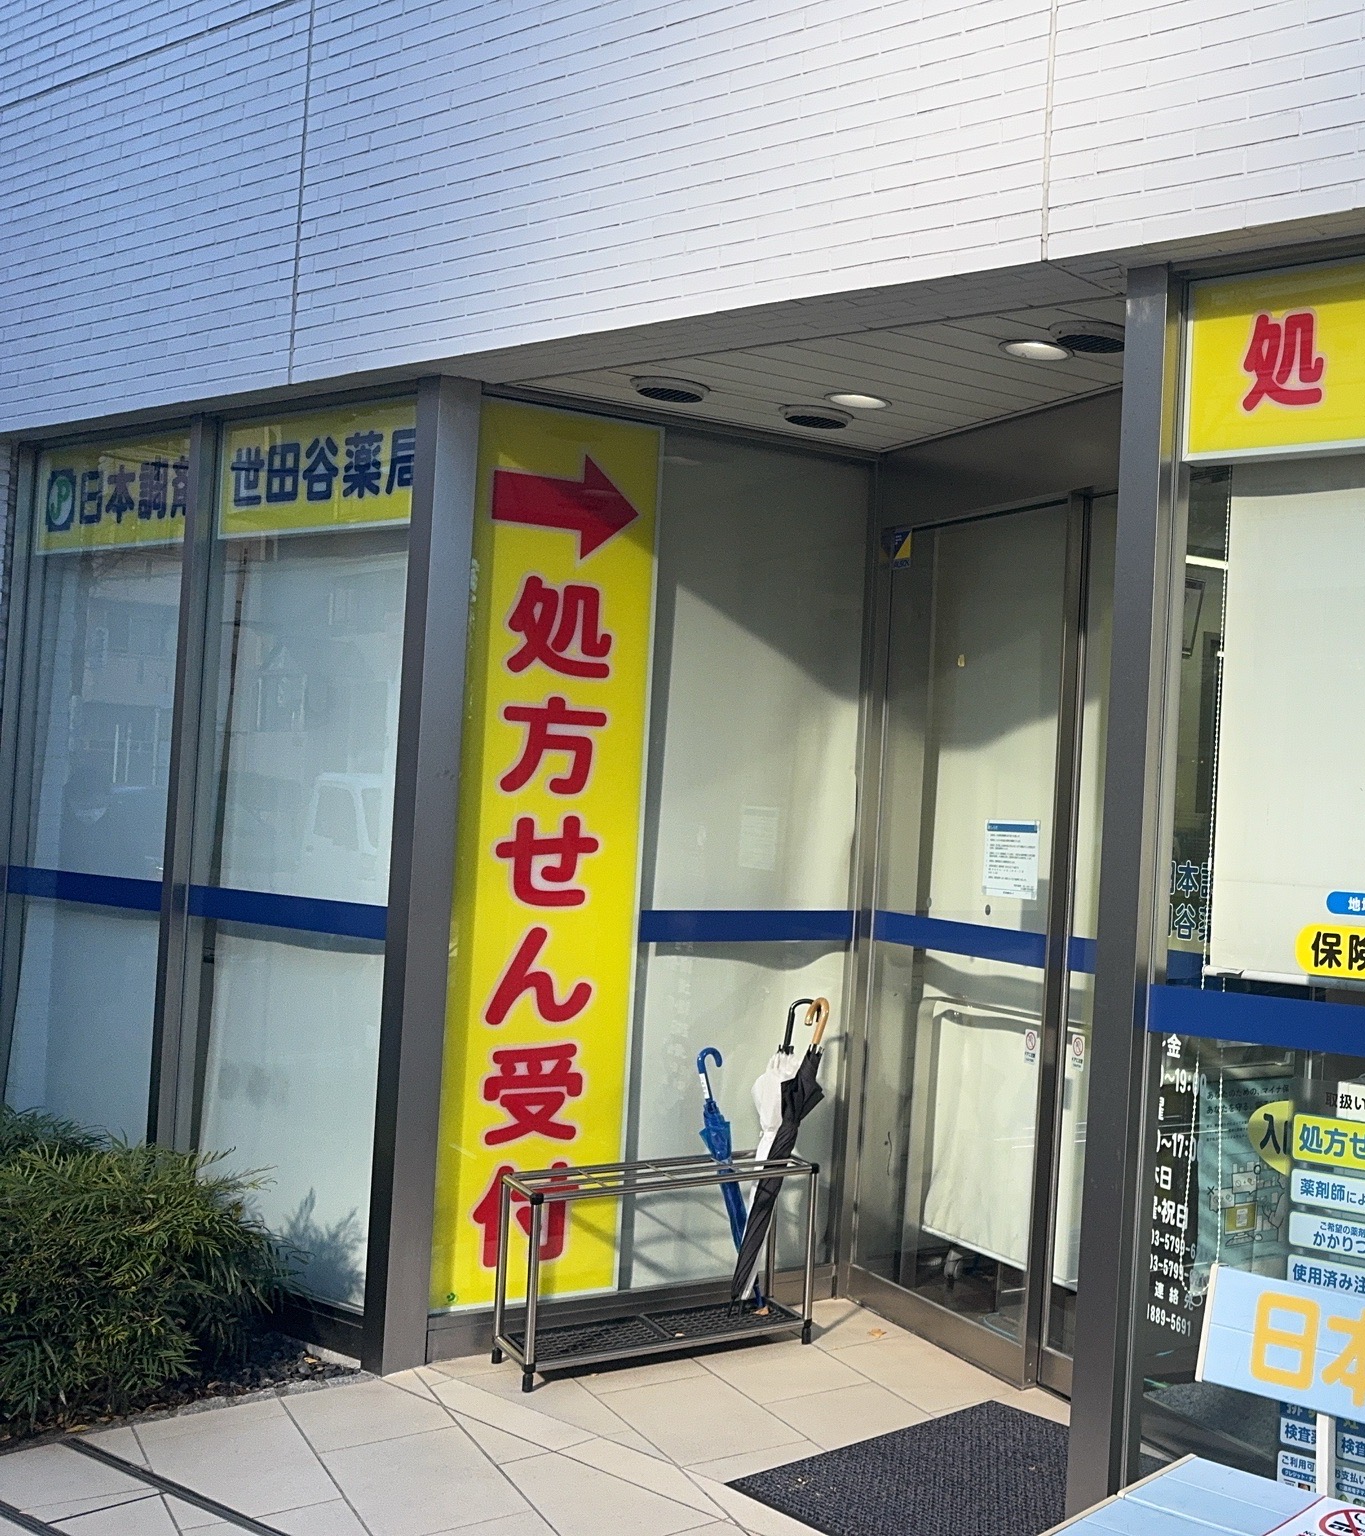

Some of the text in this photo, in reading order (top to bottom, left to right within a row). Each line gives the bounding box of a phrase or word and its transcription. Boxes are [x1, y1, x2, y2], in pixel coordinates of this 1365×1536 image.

[230, 428, 416, 507] 世田谷薬局
[472, 575, 612, 1268] 処方せん受付
[1259, 1113, 1289, 1155] 入
